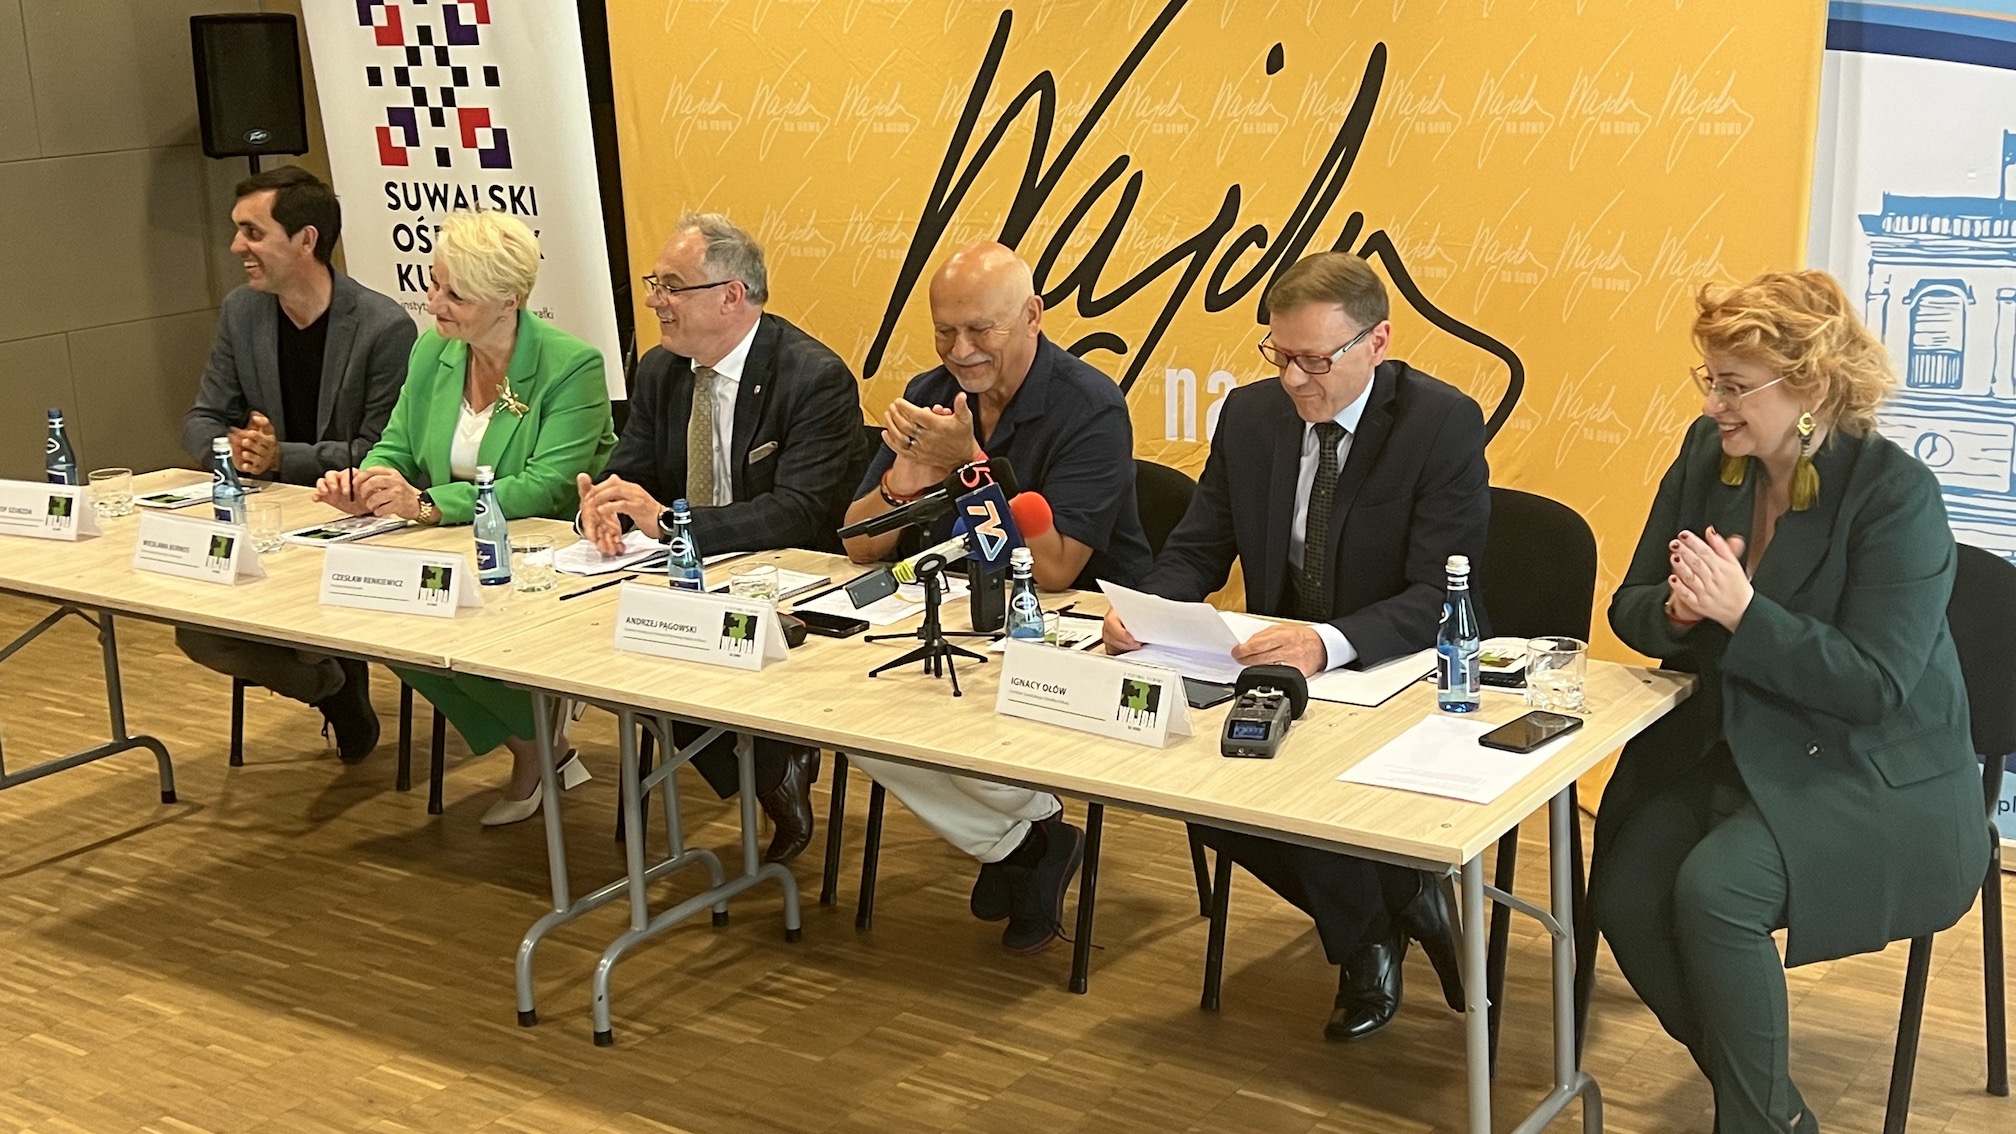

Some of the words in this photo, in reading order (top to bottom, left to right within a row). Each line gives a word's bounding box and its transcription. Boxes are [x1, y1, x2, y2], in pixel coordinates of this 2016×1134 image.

[385, 181, 538, 216] SUWALSKI
[625, 616, 658, 628] ANDRZEJ
[1010, 677, 1041, 690] IGNACY
[1042, 684, 1067, 695] OŁÓW
